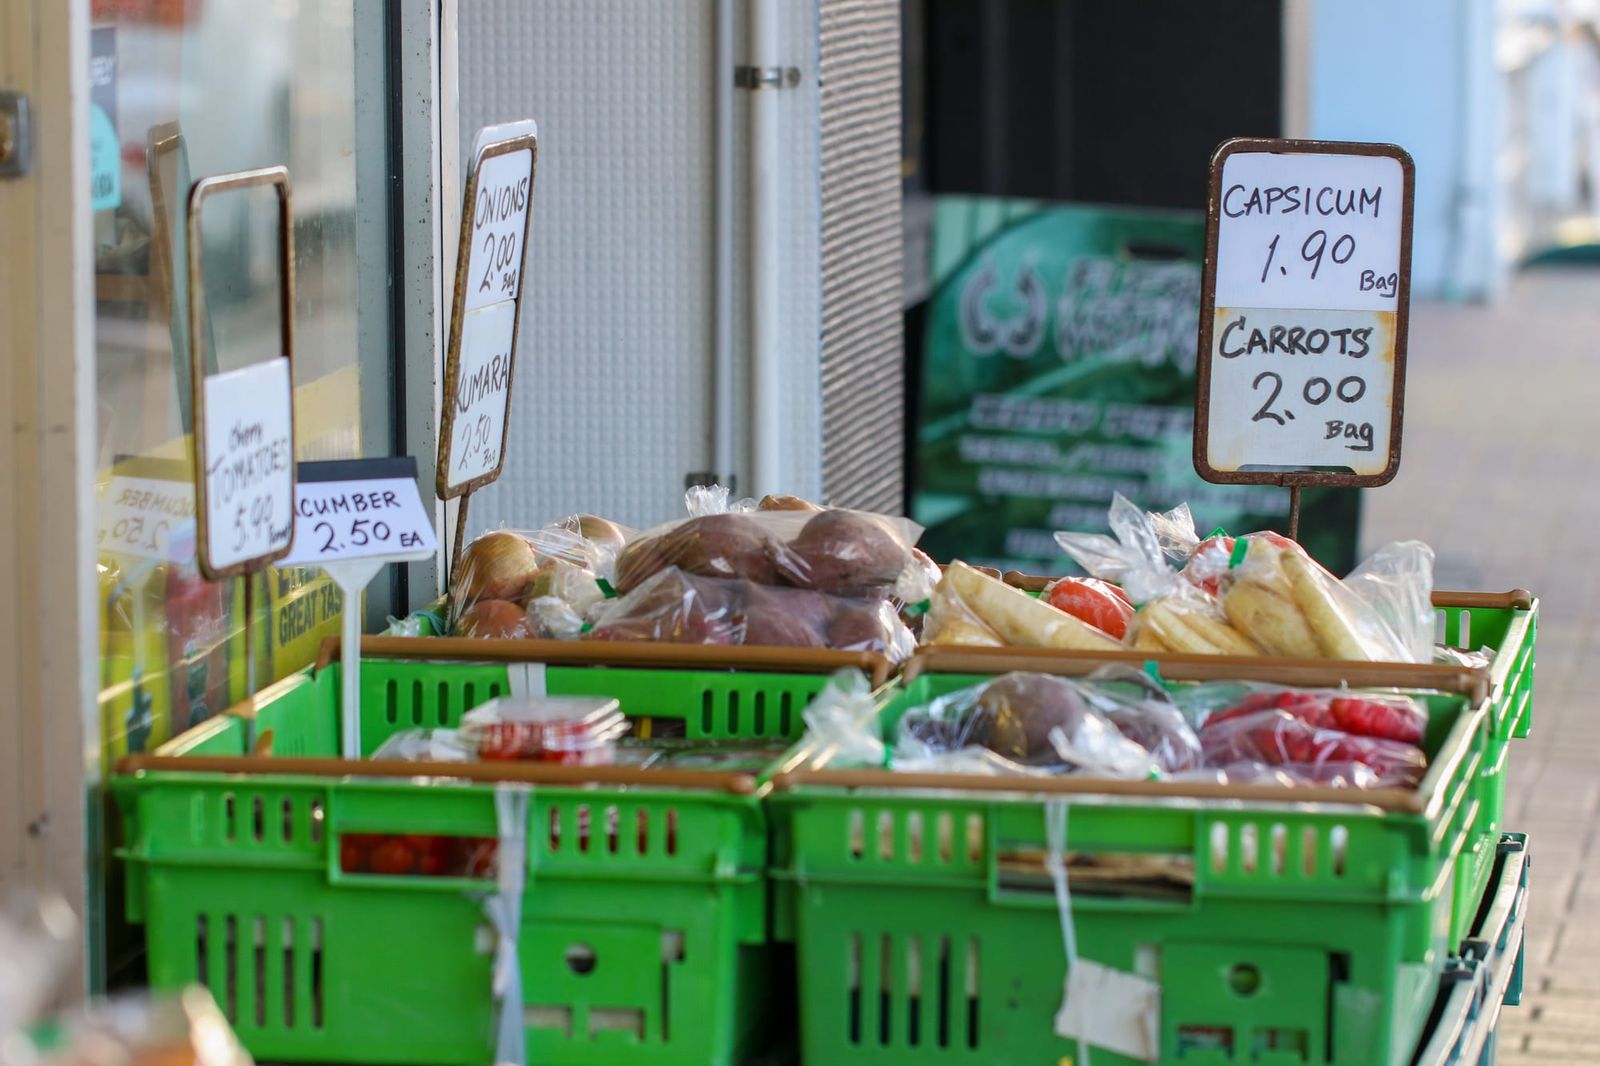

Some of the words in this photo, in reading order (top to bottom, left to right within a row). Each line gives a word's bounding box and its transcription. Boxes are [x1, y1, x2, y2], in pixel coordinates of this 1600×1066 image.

[476, 176, 528, 230] ONIONS
[1222, 184, 1382, 218] CAPSICUM
[479, 232, 516, 293] 2.00
[501, 268, 516, 297] Bag
[1261, 229, 1356, 283] 1.90
[1359, 269, 1398, 298] Bag
[1218, 315, 1374, 359] CARROTS
[456, 351, 508, 413] KUMARA
[1251, 371, 1367, 425] 2.00
[1323, 420, 1374, 451] Bag
[458, 412, 491, 471] 2.50
[294, 490, 402, 518] CUMBER
[314, 518, 391, 553] 2.50
[399, 530, 425, 547] EA
[280, 588, 318, 648] GREAT
[319, 581, 343, 622] TAS
